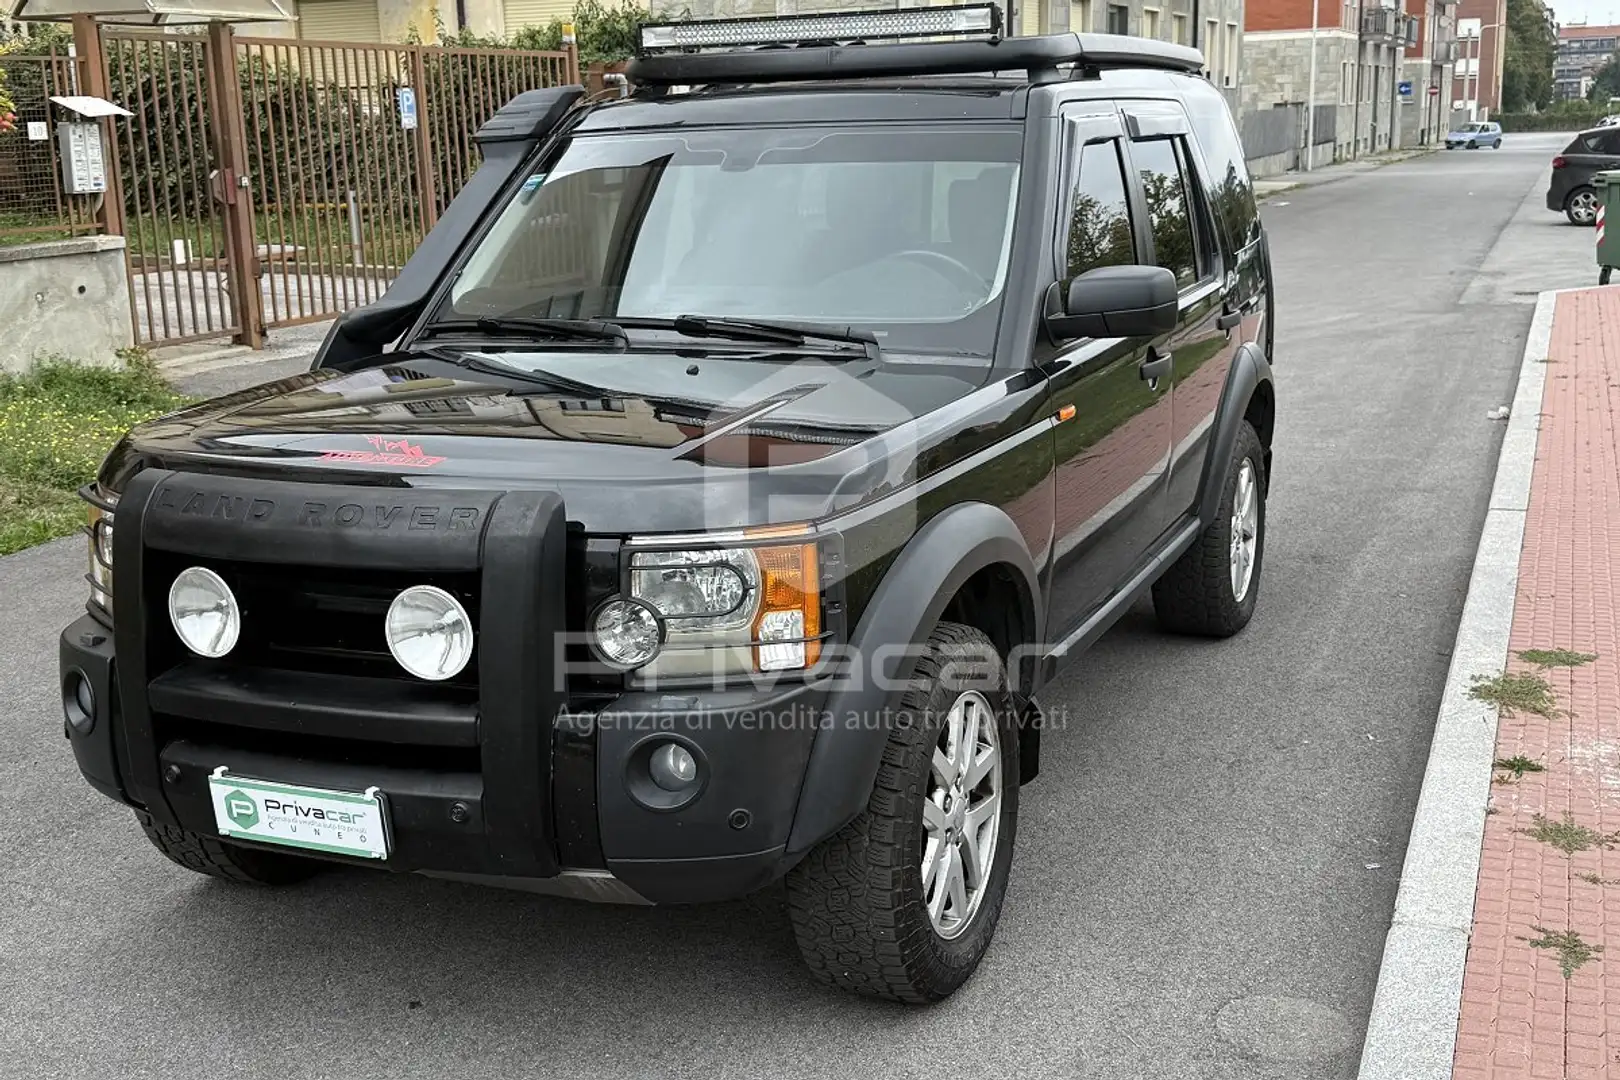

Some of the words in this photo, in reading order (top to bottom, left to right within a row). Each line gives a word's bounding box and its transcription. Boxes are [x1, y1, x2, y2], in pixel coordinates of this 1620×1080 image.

[403, 93, 413, 113] P
[153, 488, 276, 522] LAND
[300, 502, 480, 531] ROVER
[264, 799, 363, 824] Privacar
